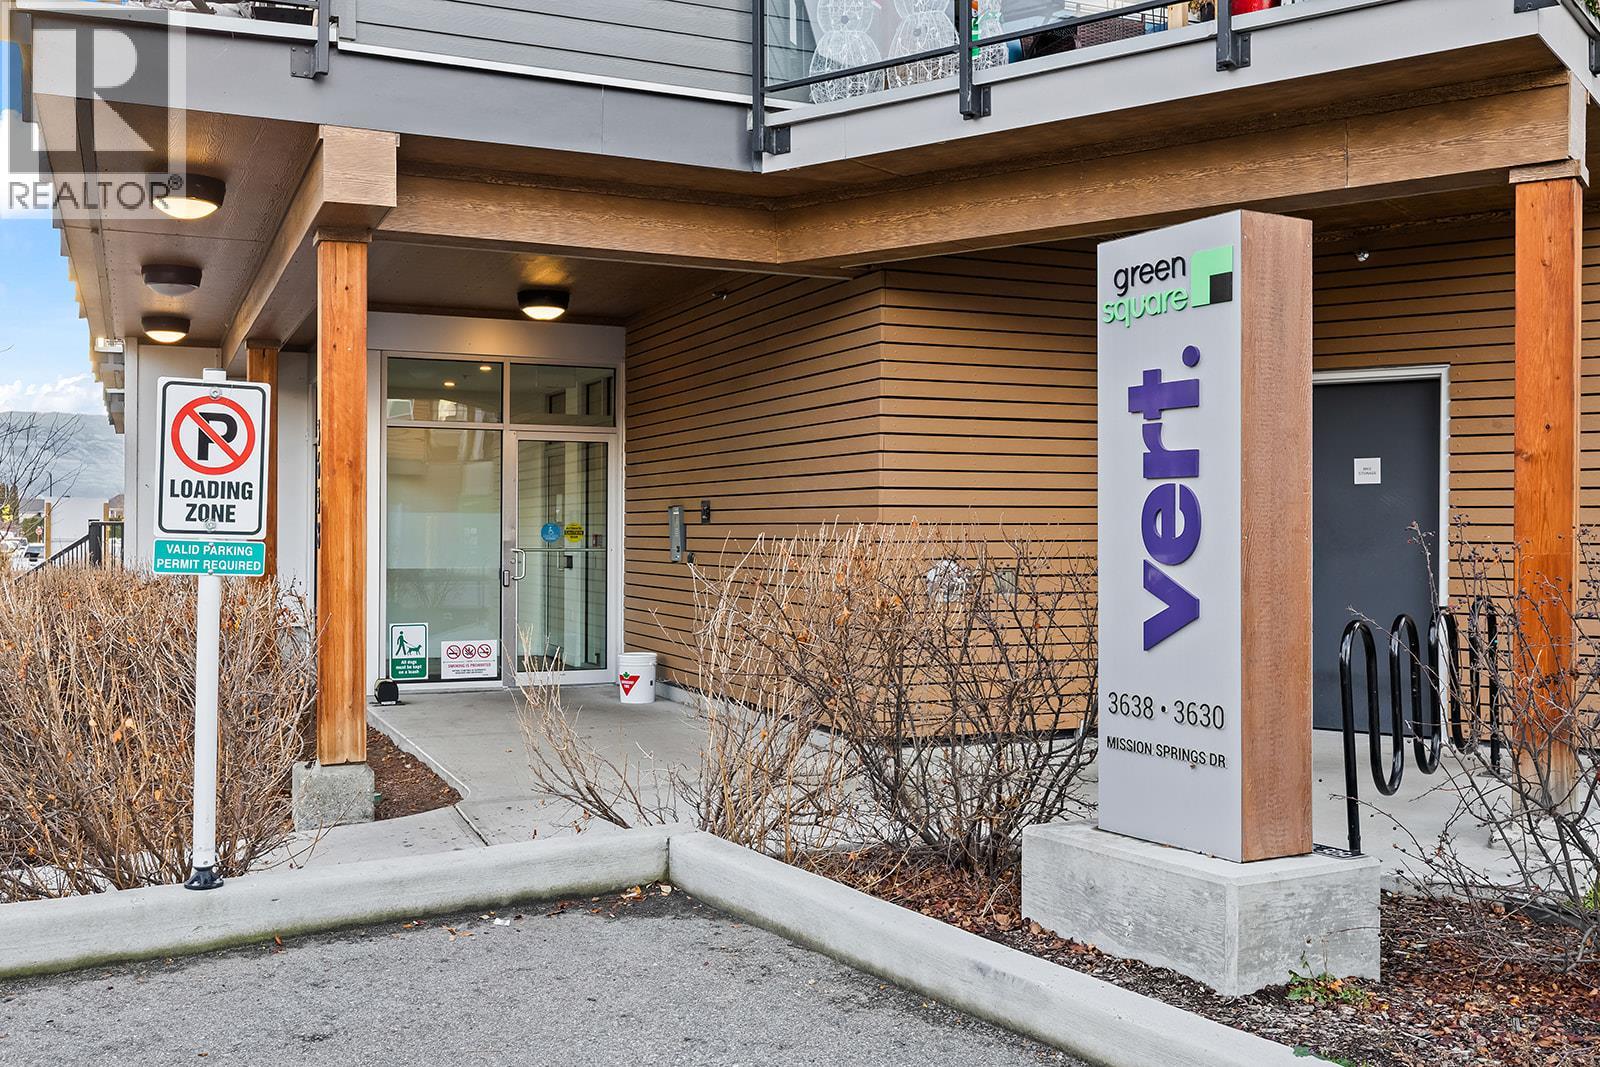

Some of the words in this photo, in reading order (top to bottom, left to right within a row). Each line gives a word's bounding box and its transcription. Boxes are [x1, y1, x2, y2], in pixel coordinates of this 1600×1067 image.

[1113, 256, 1186, 297] green
[1103, 287, 1189, 328] square
[170, 479, 253, 500] LOADING
[185, 503, 236, 523] ZONE
[166, 544, 200, 555] VALID
[203, 545, 253, 556] PARKING
[156, 558, 200, 569] PERMIT
[203, 559, 262, 571] REQUIRED
[1108, 691, 1154, 720] 3638
[1173, 700, 1225, 730] 3630
[1106, 736, 1152, 756] MISSION
[1155, 743, 1206, 765] SPRINGS
[1209, 752, 1226, 768] DR
